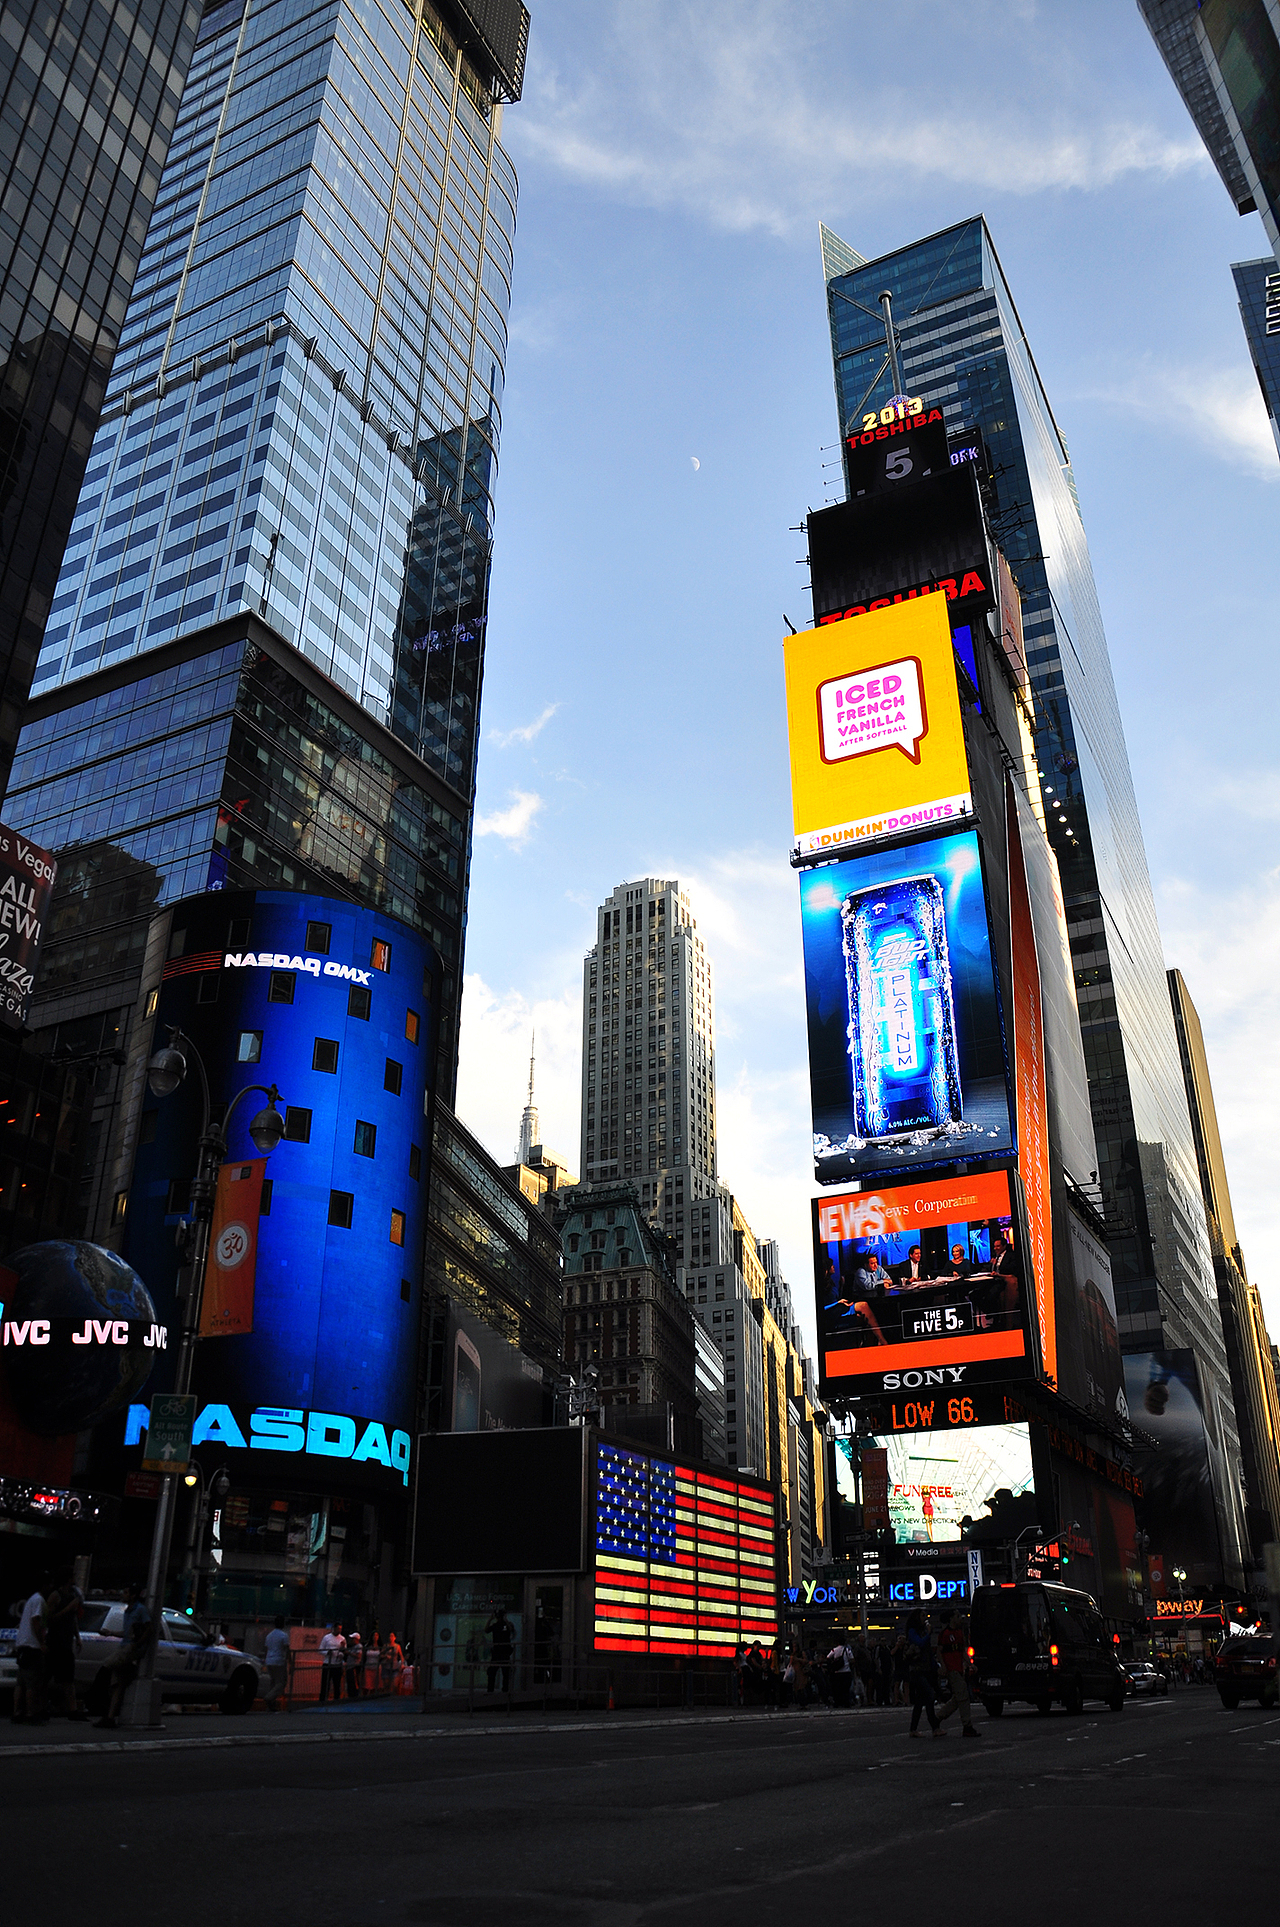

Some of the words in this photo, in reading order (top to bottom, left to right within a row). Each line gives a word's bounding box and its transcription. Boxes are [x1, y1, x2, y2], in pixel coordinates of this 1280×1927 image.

[862, 397, 924, 432] 2013
[847, 409, 943, 450] TOSHIBA
[836, 675, 902, 708] ICED
[837, 695, 905, 724] FRENCH
[838, 711, 906, 737] VANILLA
[839, 736, 864, 748] AFTER
[866, 725, 908, 741] SOFTBALL
[887, 804, 953, 830] DONUTS
[15, 839, 57, 886] Vegas
[1, 874, 37, 914] ALL
[0, 900, 42, 947] EW!
[224, 953, 321, 977] NASDAQ
[323, 961, 371, 986] OMX
[890, 974, 913, 1067] PLATINUM
[913, 1319, 943, 1334] FIVE
[923, 1310, 942, 1320] THE
[71, 1320, 129, 1345] JVC
[143, 1323, 168, 1350] JVC
[882, 1366, 967, 1390] SONY
[892, 1400, 935, 1429] LOW
[948, 1397, 979, 1424] 66.
[155, 1431, 185, 1441] South
[864, 1505, 880, 1514] JUNE
[918, 1574, 968, 1601] DEPT
[185, 1650, 220, 1672] NYPD
